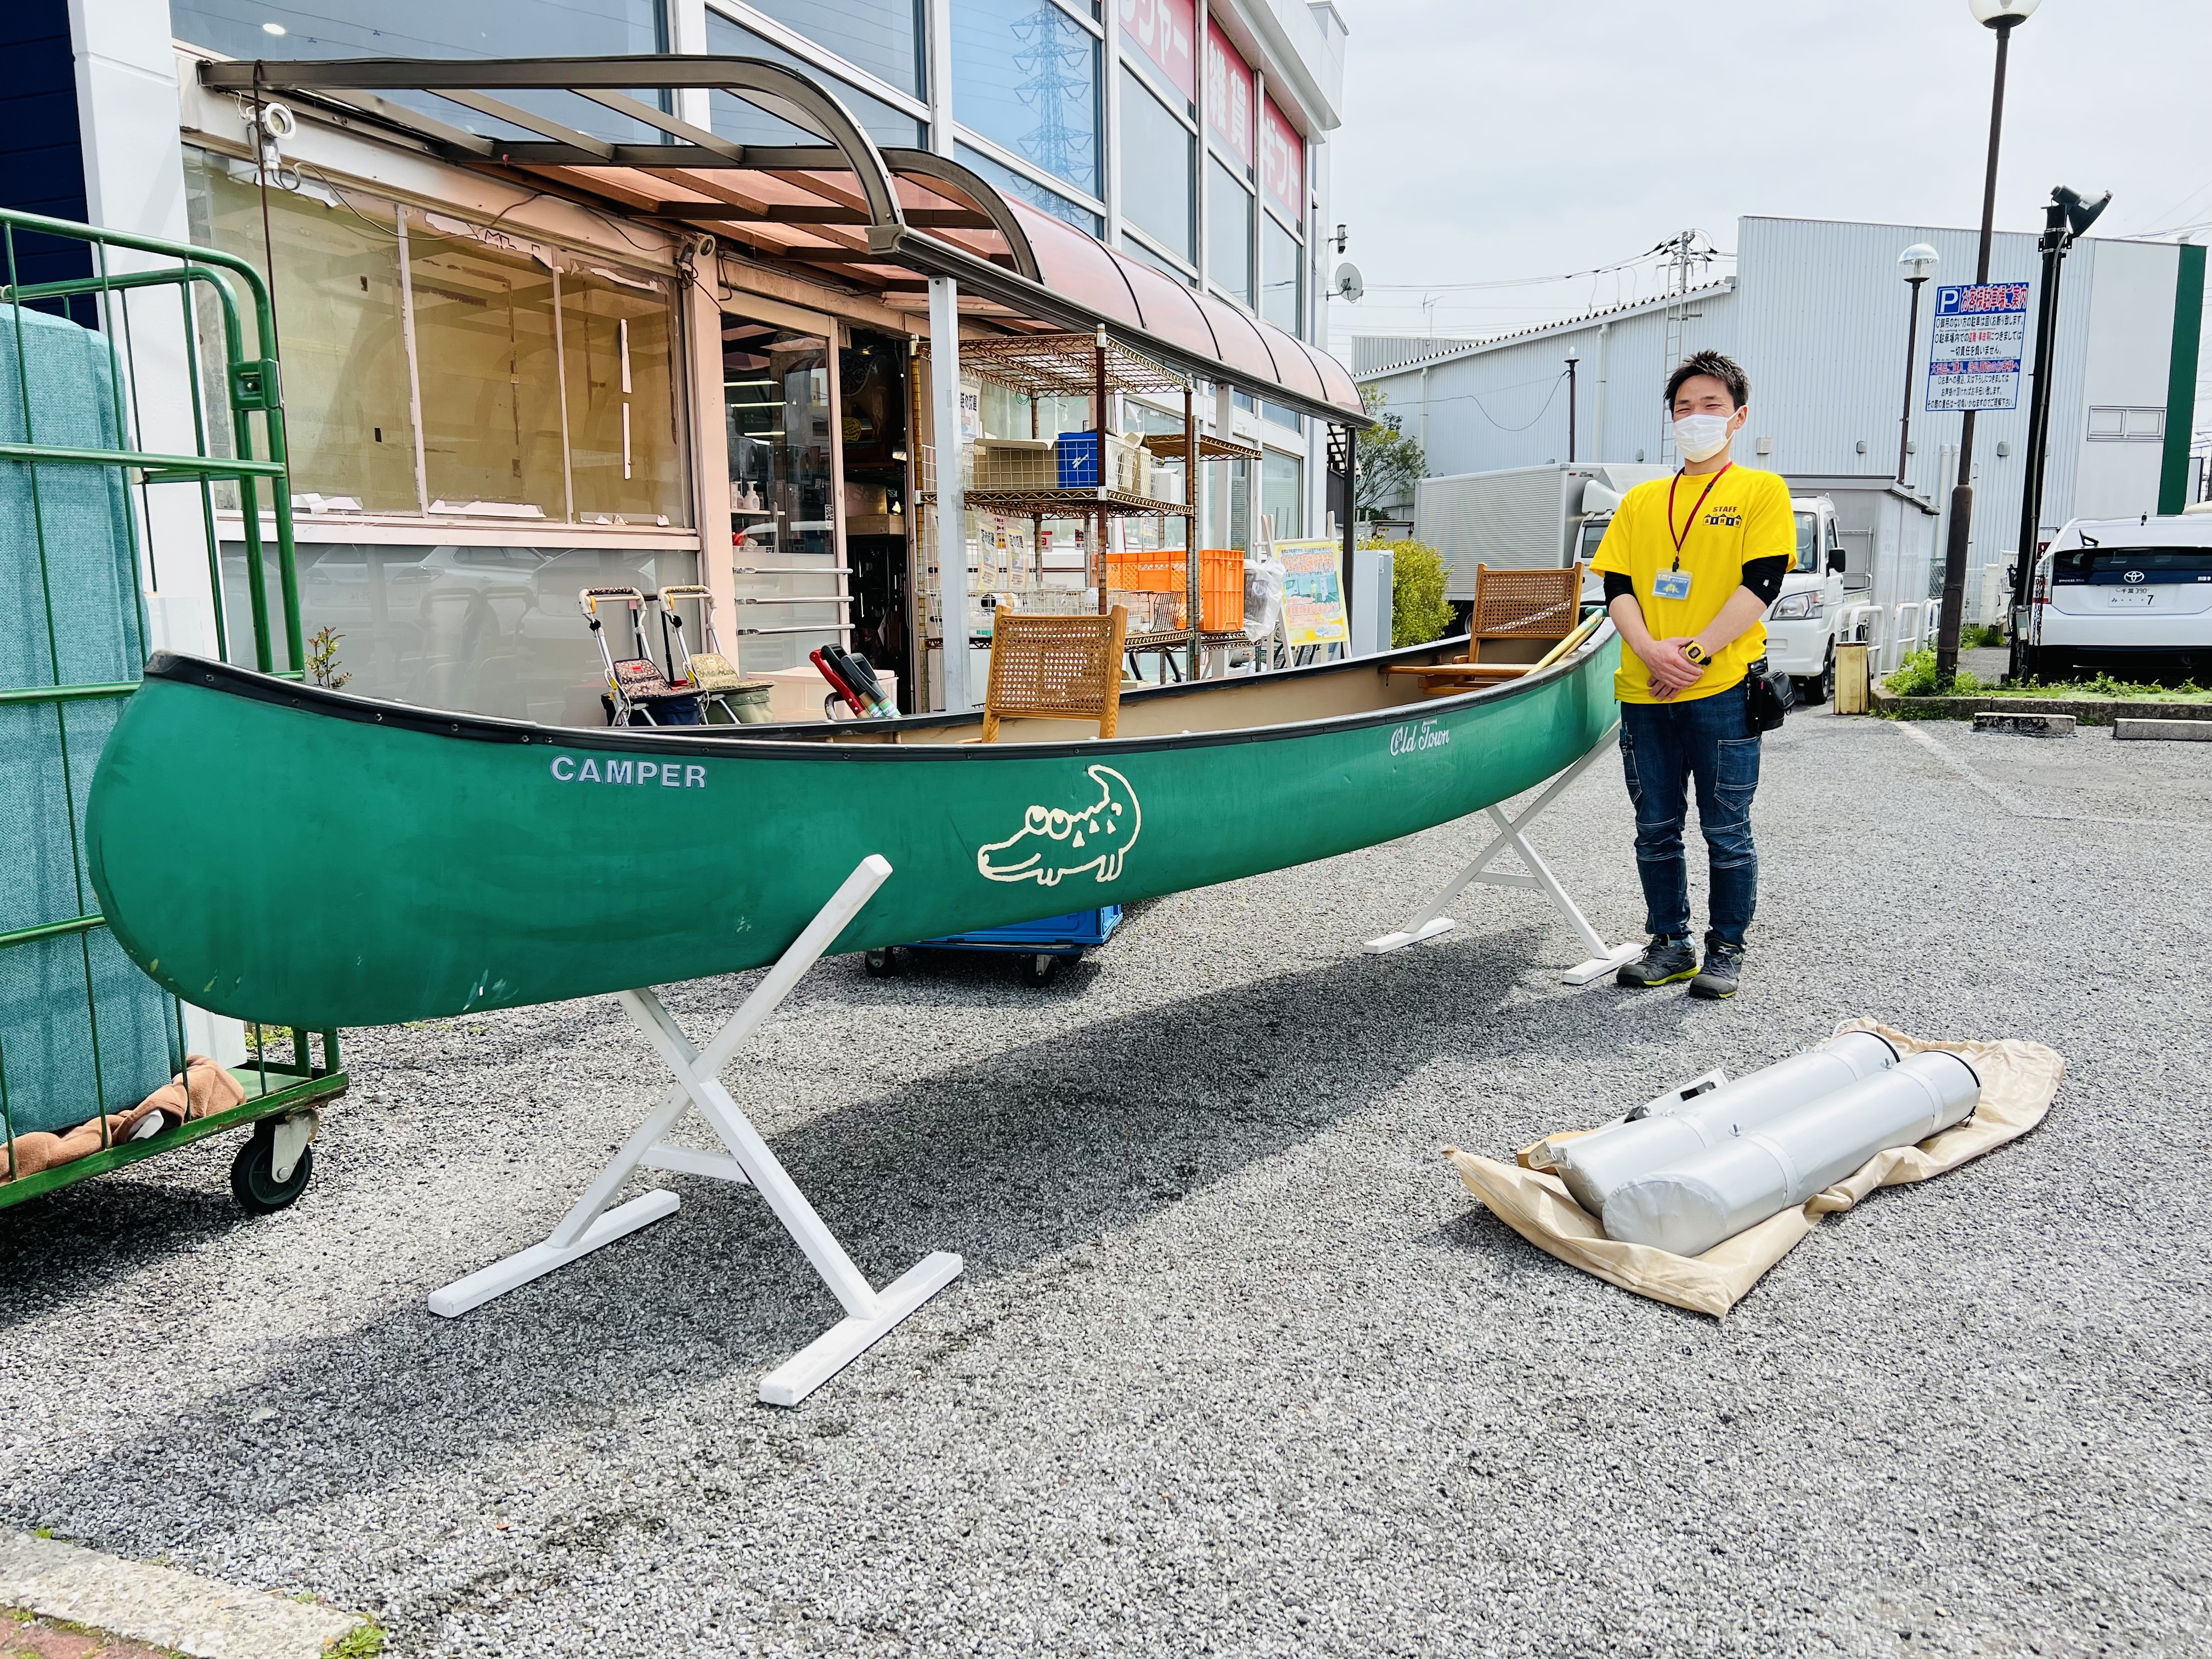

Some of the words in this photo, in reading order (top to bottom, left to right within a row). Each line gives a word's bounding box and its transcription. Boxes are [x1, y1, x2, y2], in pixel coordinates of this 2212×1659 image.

[1209, 40, 1246, 156] 雑貨
[1263, 116, 1299, 207] ギフト
[1940, 290, 1959, 313] P
[2147, 595, 2154, 605] 7
[1390, 725, 1417, 757] Old
[1418, 718, 1450, 751] Town
[550, 755, 707, 789] CAMPER
